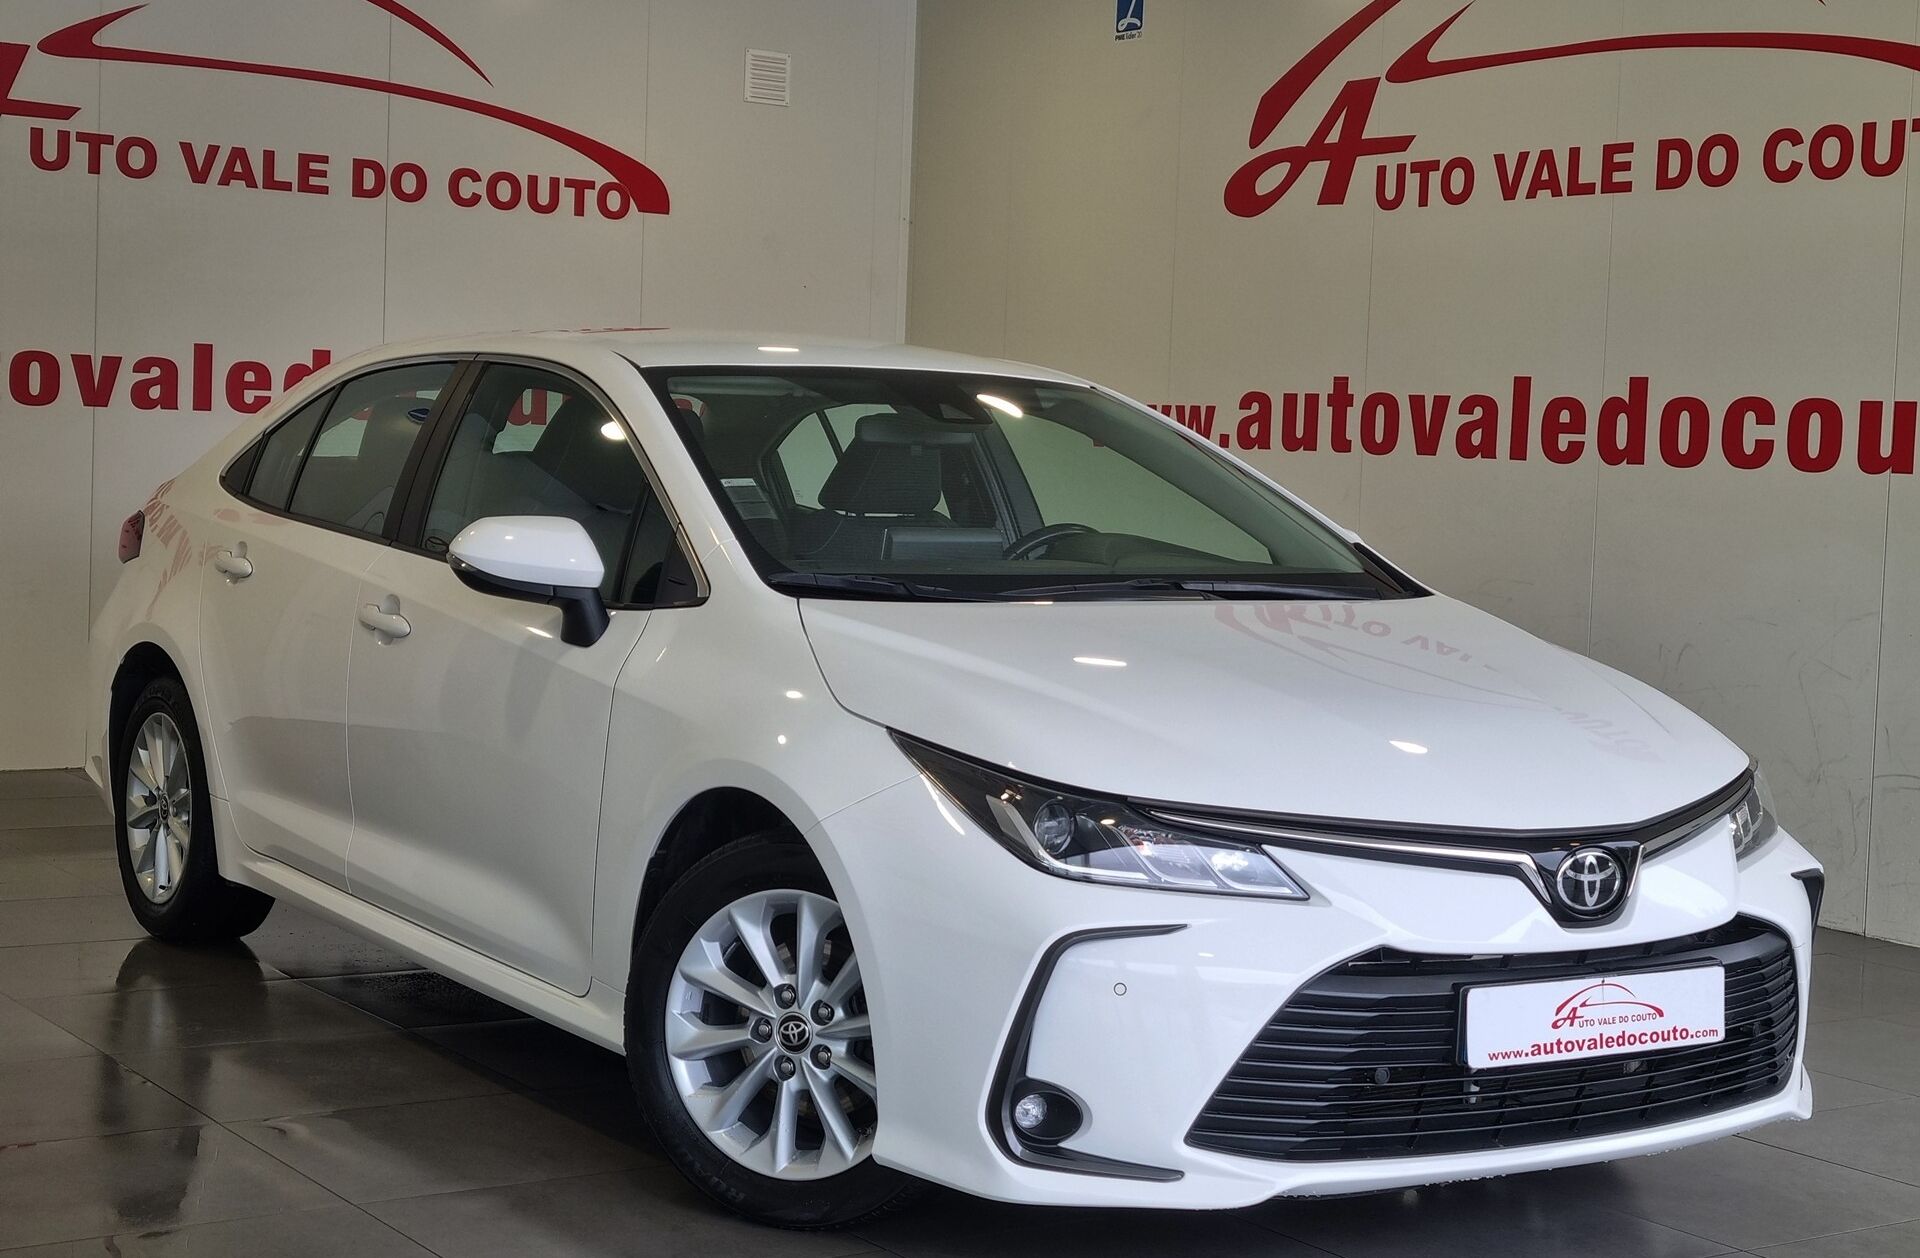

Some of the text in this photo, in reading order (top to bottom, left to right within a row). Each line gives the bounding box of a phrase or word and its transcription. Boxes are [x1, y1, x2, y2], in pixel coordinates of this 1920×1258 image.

[179, 141, 330, 196] VALE
[351, 157, 429, 204] DO
[447, 167, 632, 221] COUTO
[1492, 141, 1636, 202] VALE
[1655, 132, 1740, 192] DO
[1761, 116, 1920, 184] COU
[1487, 1025, 1719, 1061] www.autovaledocouto.com
[1551, 1006, 1658, 1030] AUTO VALE DO COUTO
